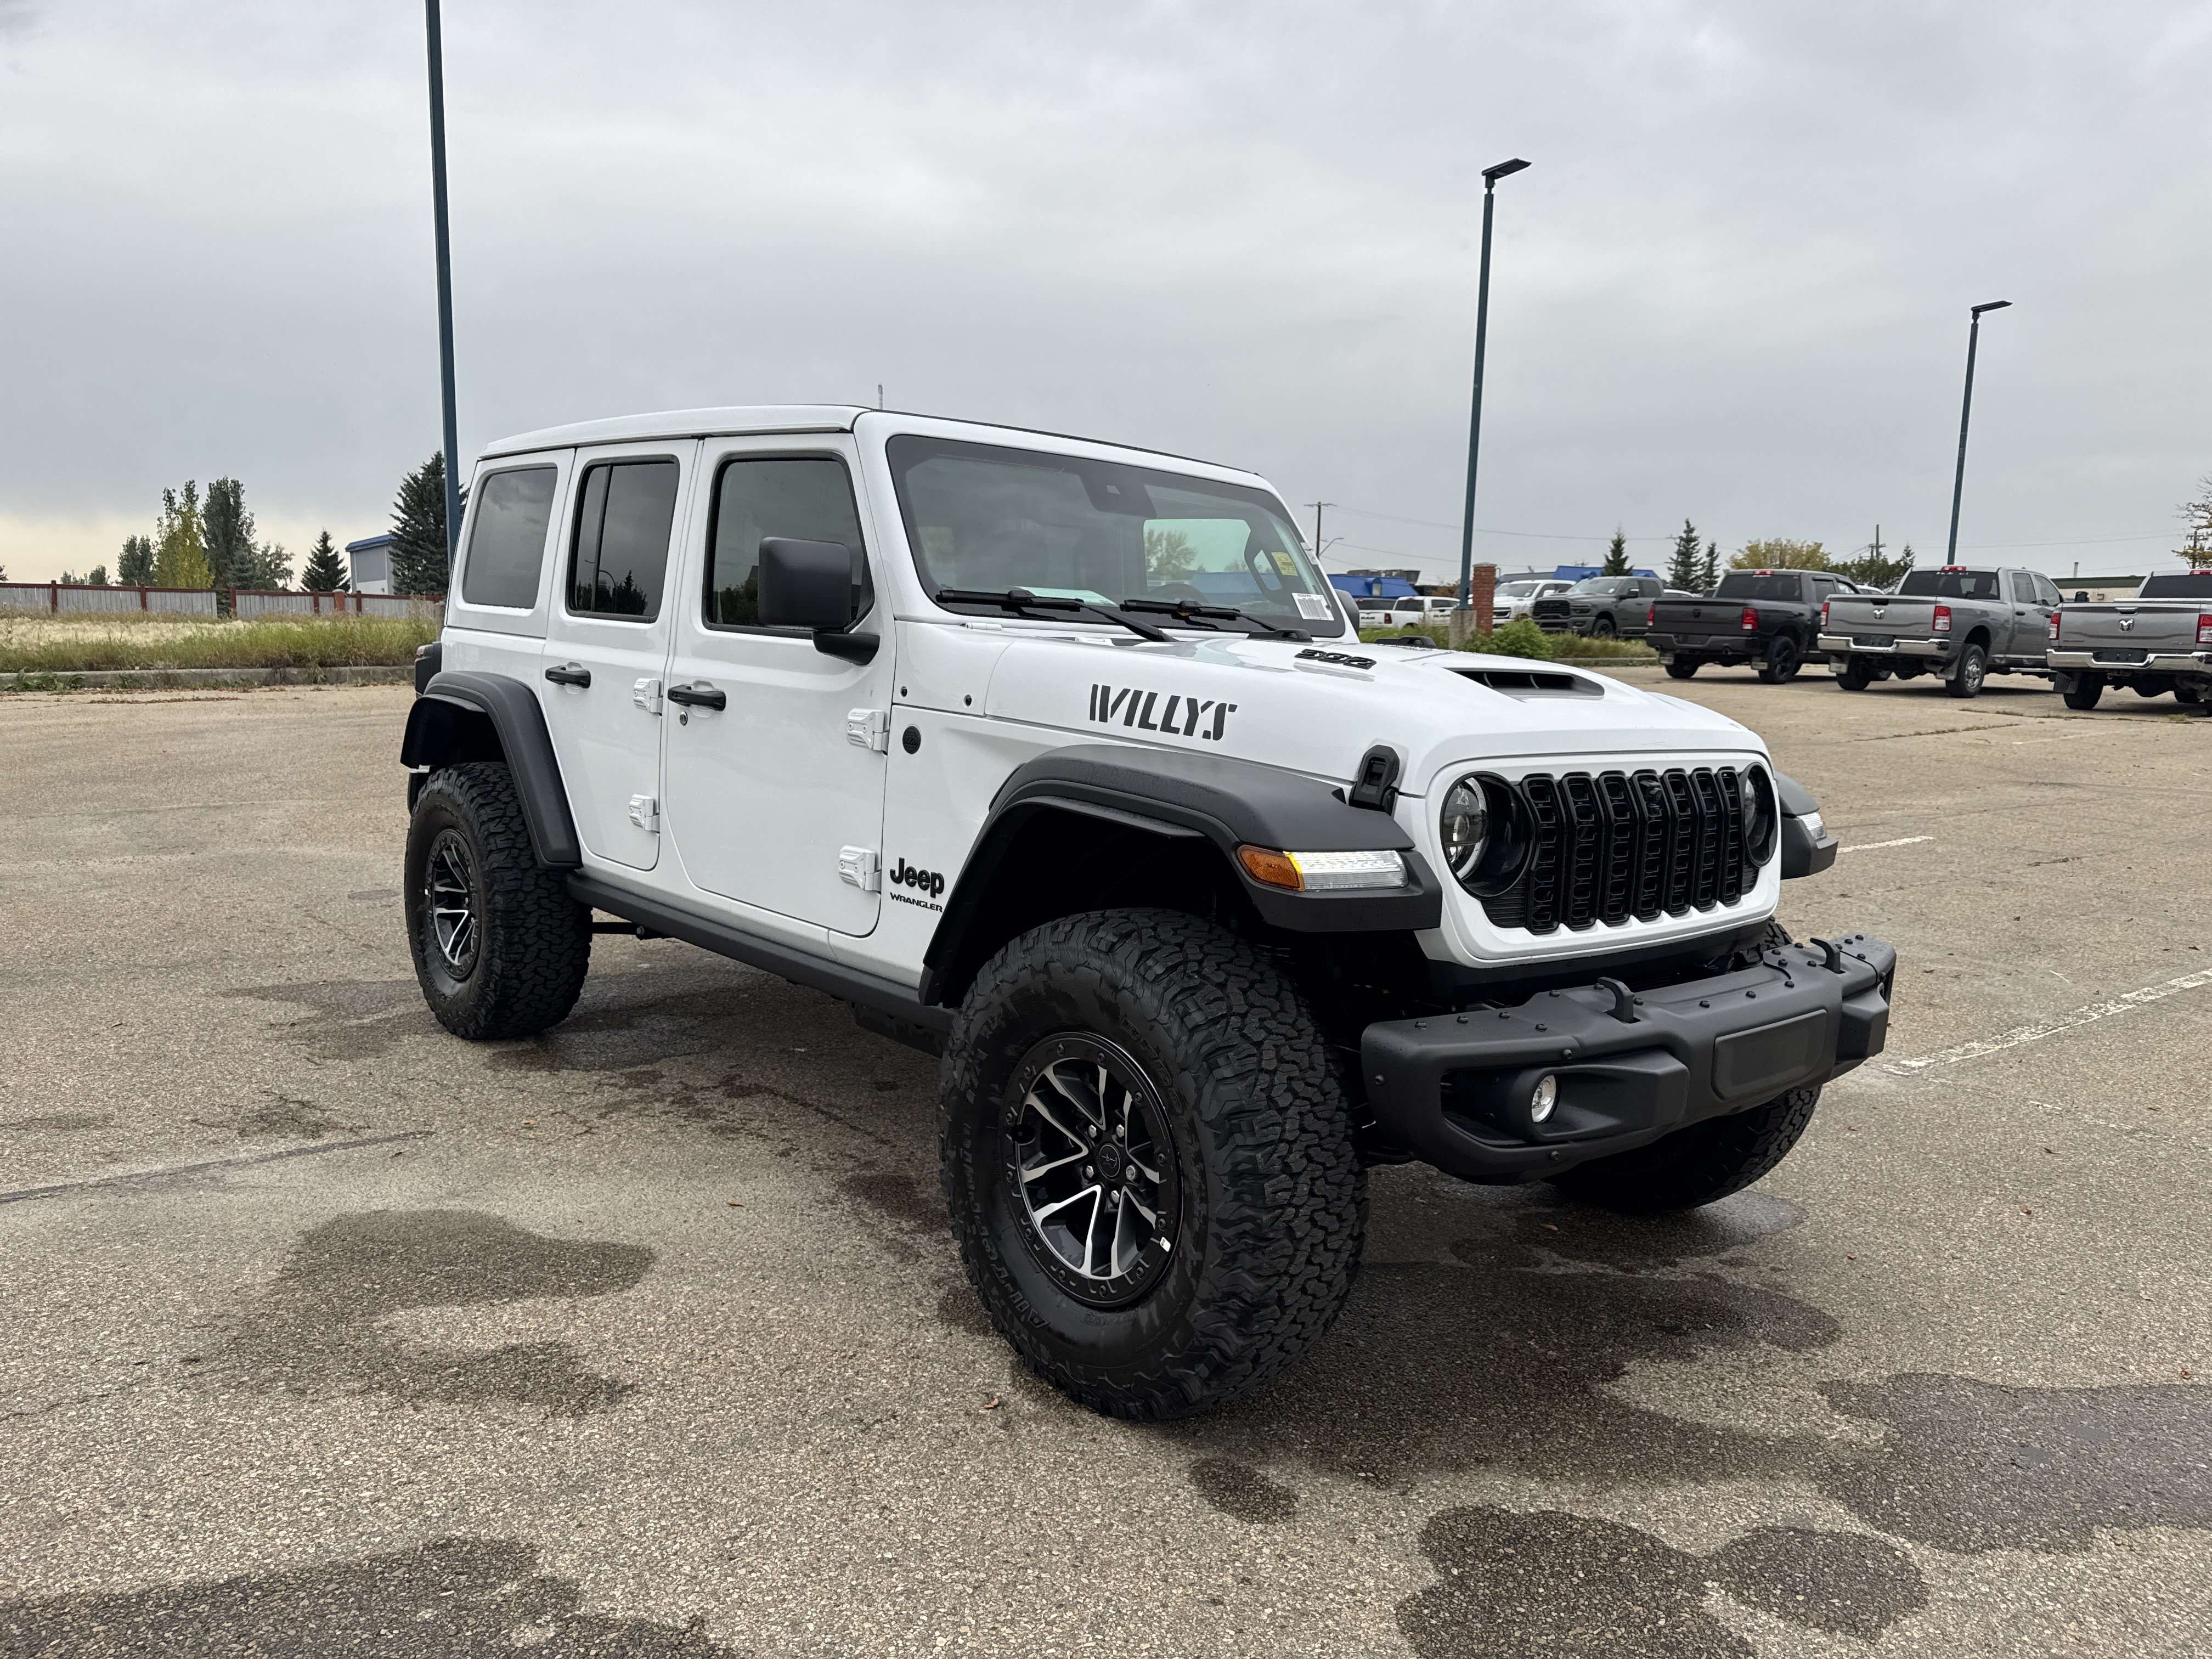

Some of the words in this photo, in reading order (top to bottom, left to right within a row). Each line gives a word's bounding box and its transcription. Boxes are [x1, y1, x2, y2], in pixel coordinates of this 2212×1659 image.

[1294, 648, 1377, 669] 392
[1089, 684, 1238, 741] WILLYS
[889, 857, 945, 899] Jeep
[889, 891, 943, 913] WRANGLER
